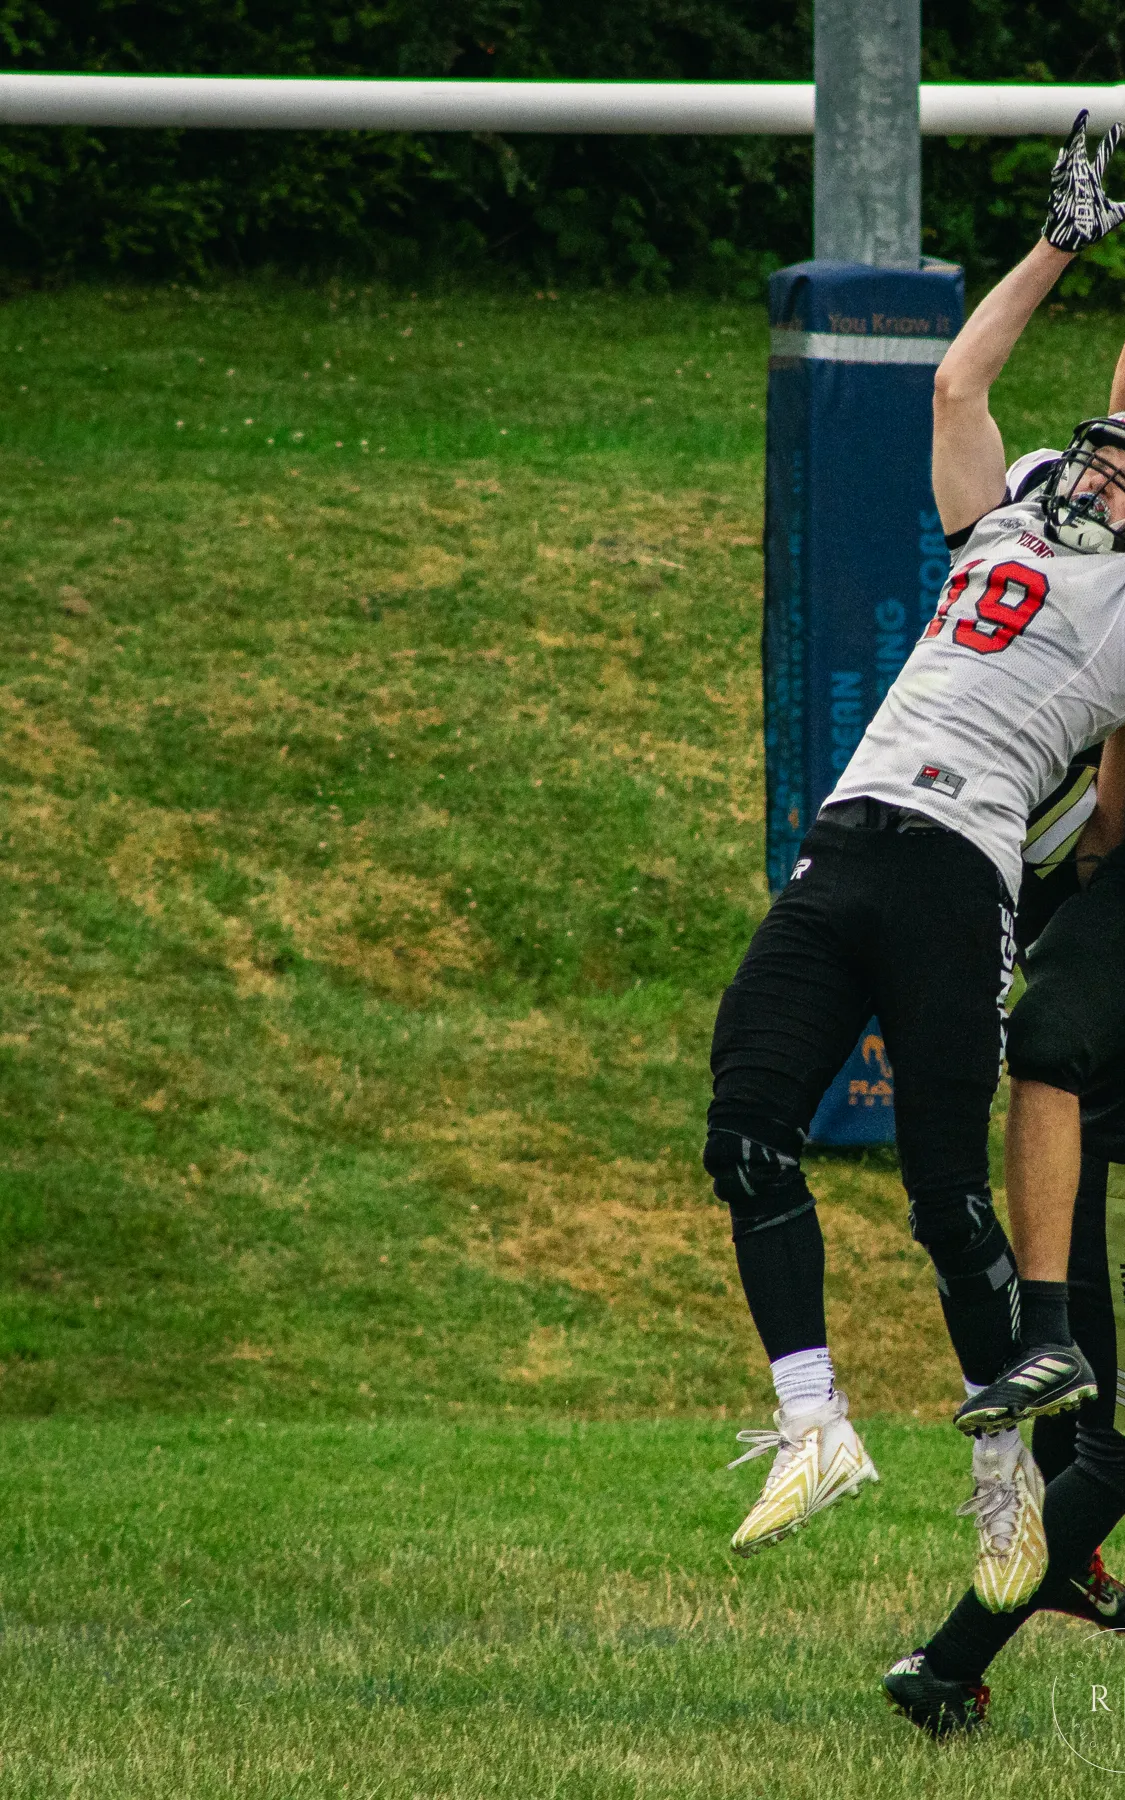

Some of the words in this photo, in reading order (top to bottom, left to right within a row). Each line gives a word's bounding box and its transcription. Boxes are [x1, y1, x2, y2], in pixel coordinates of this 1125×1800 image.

[828, 312, 867, 333] You
[872, 313, 931, 334] Know
[924, 558, 1050, 655] 19
